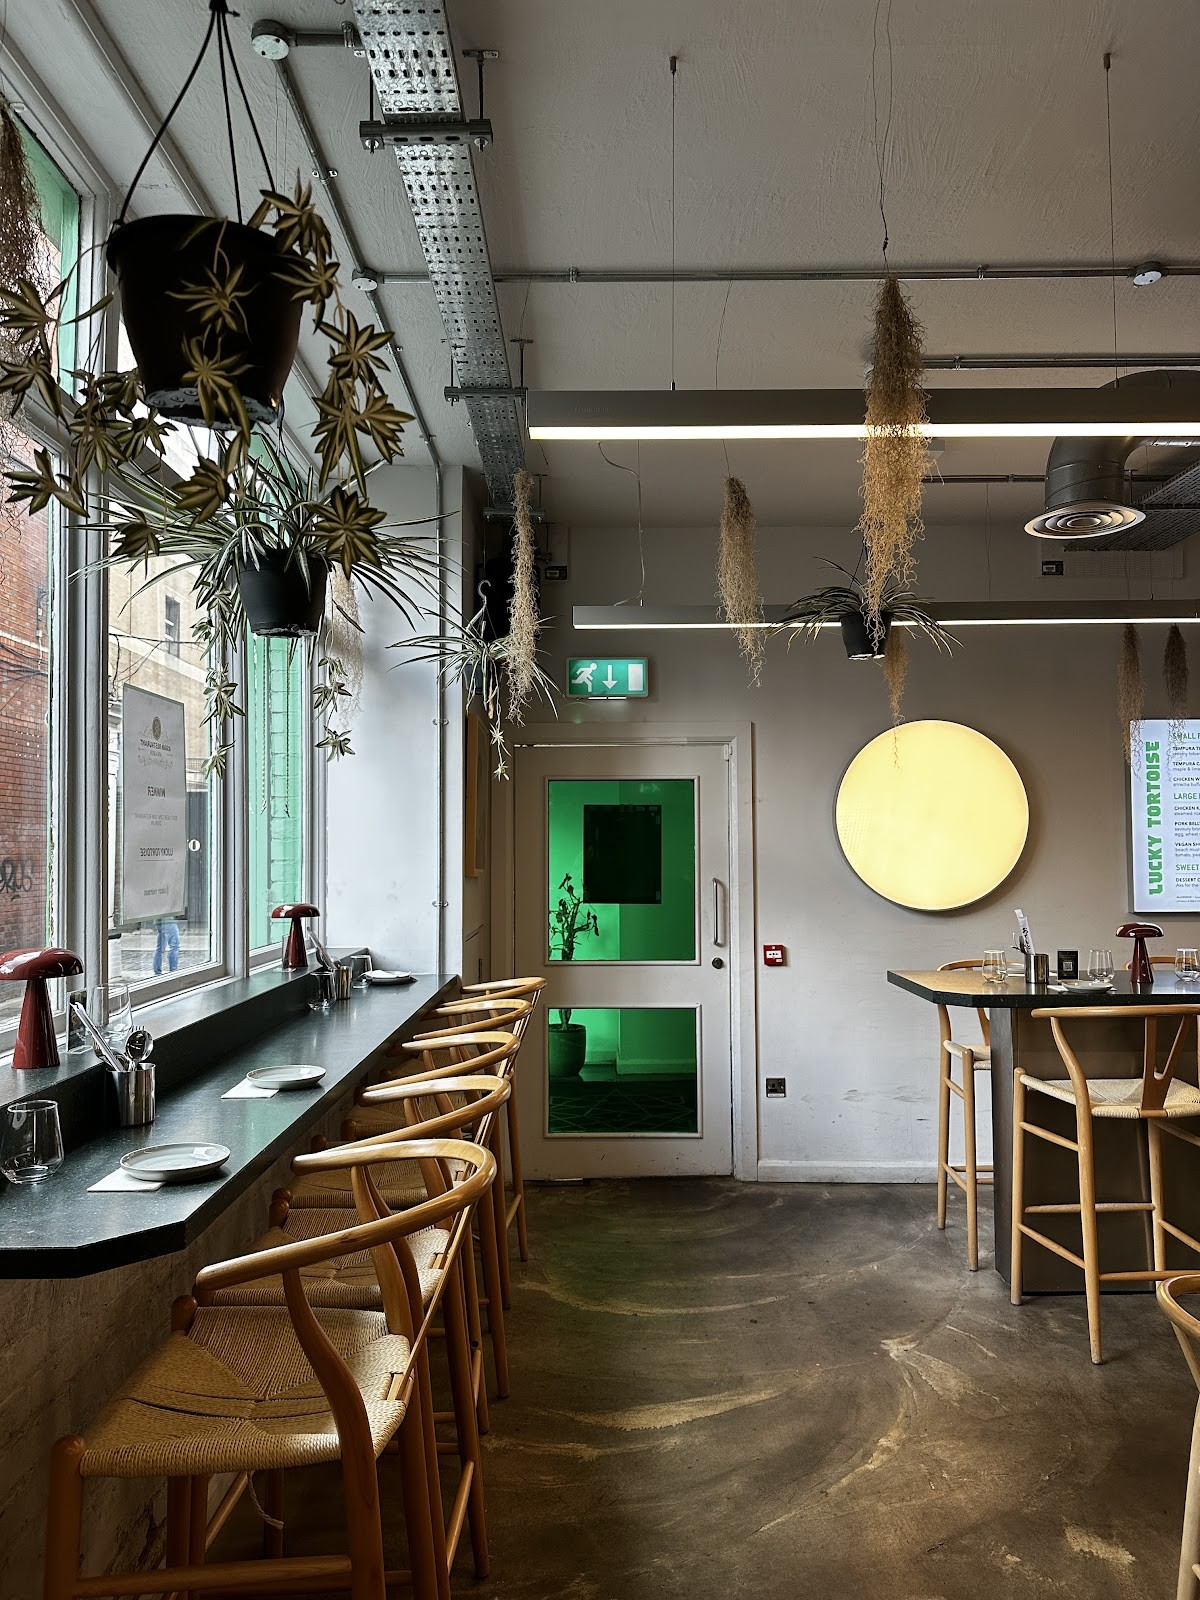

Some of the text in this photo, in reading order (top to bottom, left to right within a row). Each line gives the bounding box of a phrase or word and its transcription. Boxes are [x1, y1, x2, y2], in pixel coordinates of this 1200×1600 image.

[1172, 732, 1196, 740] SMALL
[1173, 792, 1197, 800] LARGE
[1145, 741, 1163, 895] LUCKY TORTOISE
